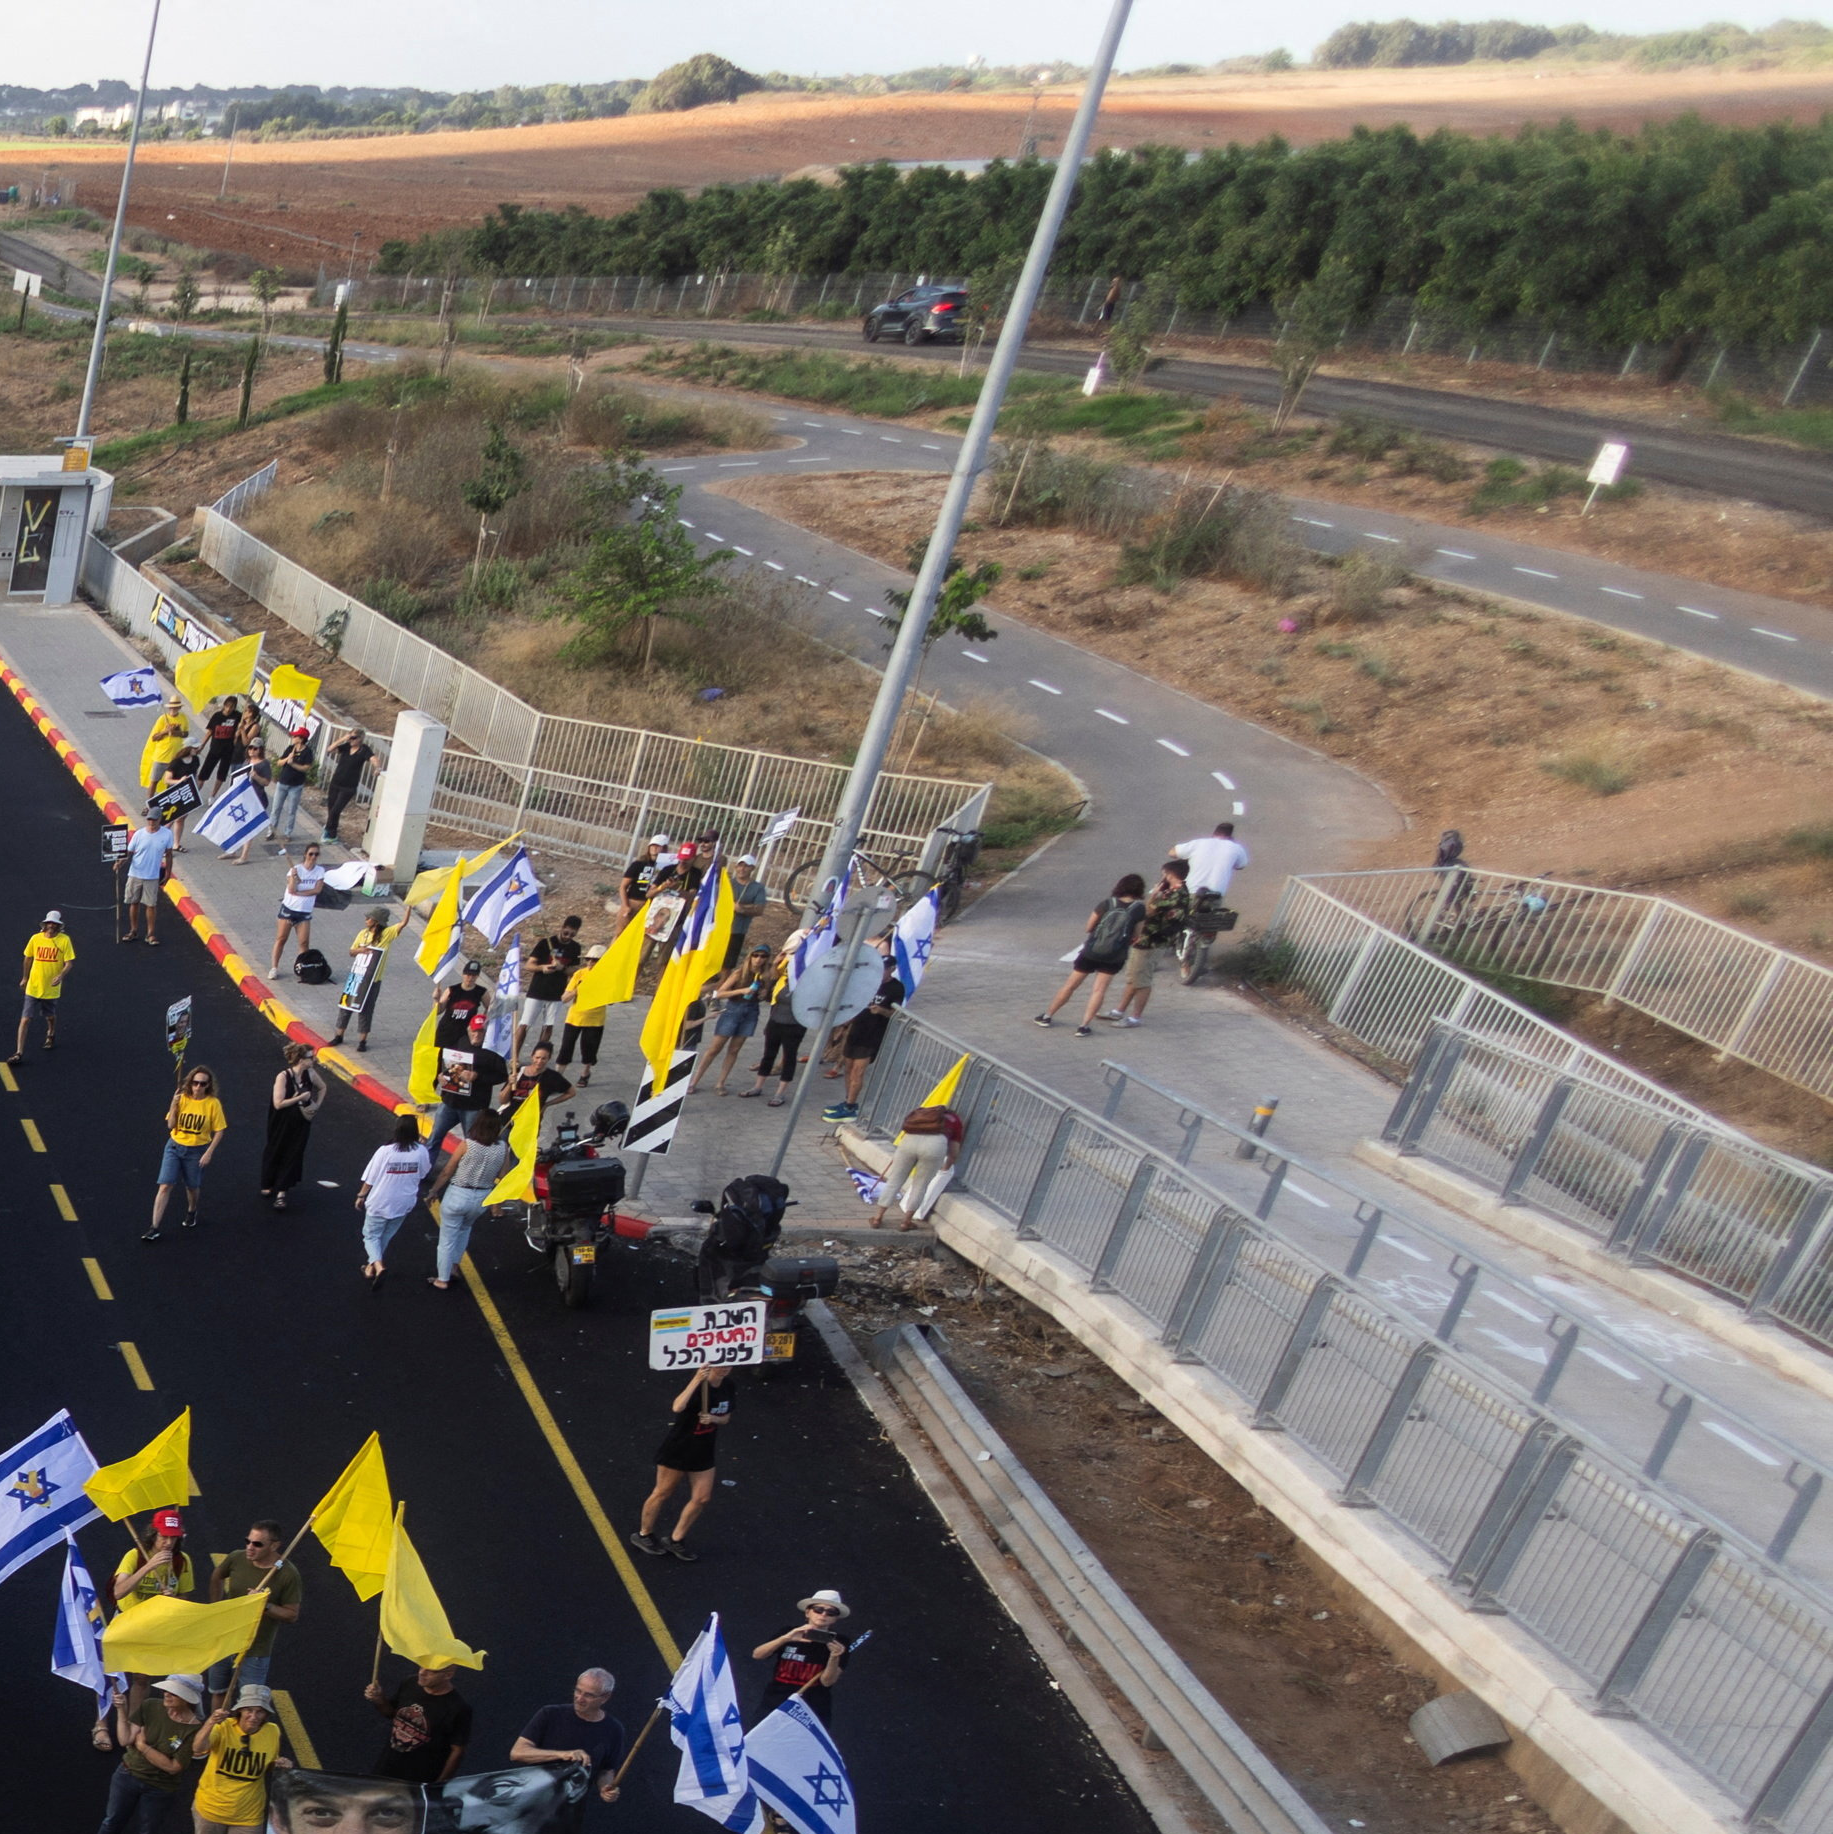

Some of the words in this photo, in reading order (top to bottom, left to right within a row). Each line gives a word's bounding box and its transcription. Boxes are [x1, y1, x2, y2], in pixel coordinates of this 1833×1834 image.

[37, 946, 59, 959] NOW
[178, 1113, 206, 1131] NOW
[697, 1306, 757, 1333] השבת
[686, 1327, 758, 1349] החטופים
[663, 1346, 706, 1368] הכל
[708, 1343, 755, 1366] לפני
[219, 1747, 267, 1777] NOW
